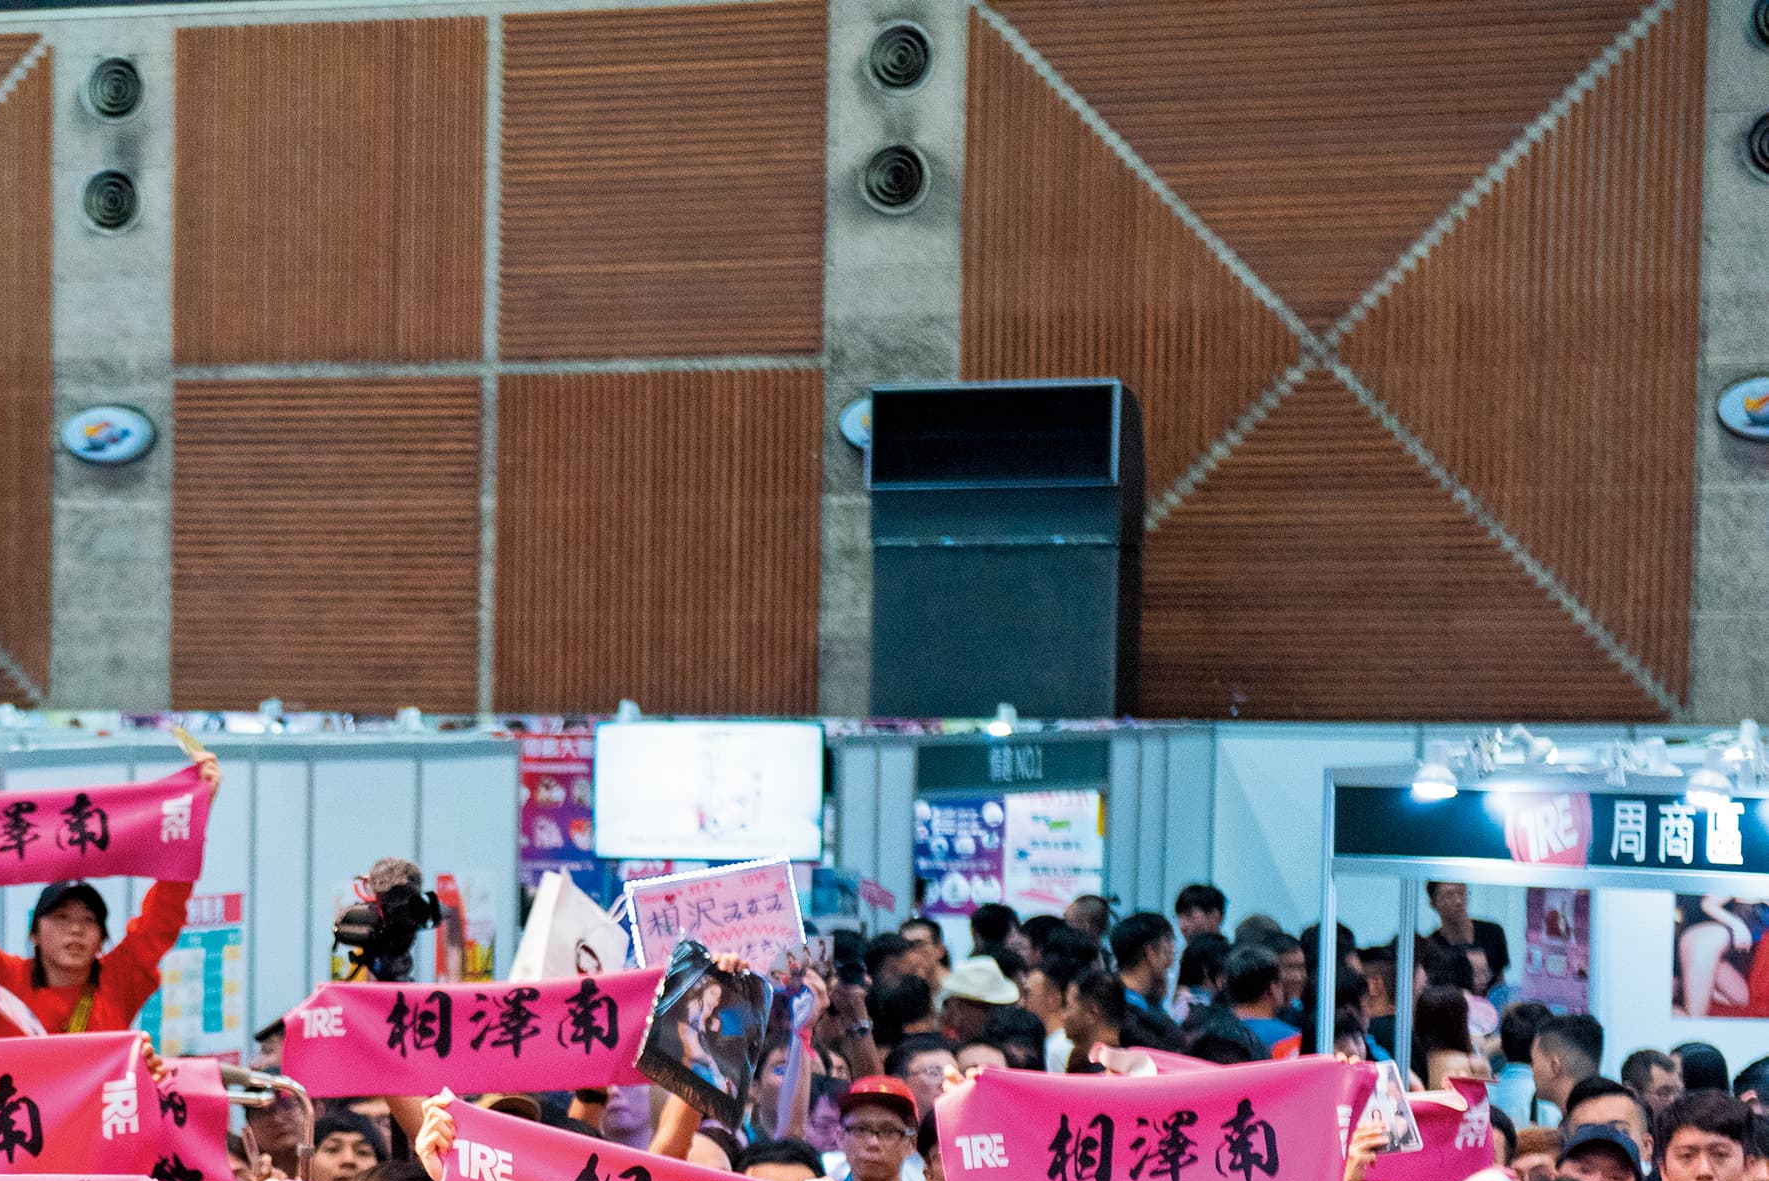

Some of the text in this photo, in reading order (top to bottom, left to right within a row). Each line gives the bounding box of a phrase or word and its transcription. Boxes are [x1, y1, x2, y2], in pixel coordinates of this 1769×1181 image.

[1611, 798, 1746, 866] 周商區
[386, 977, 619, 1058] 相澤南
